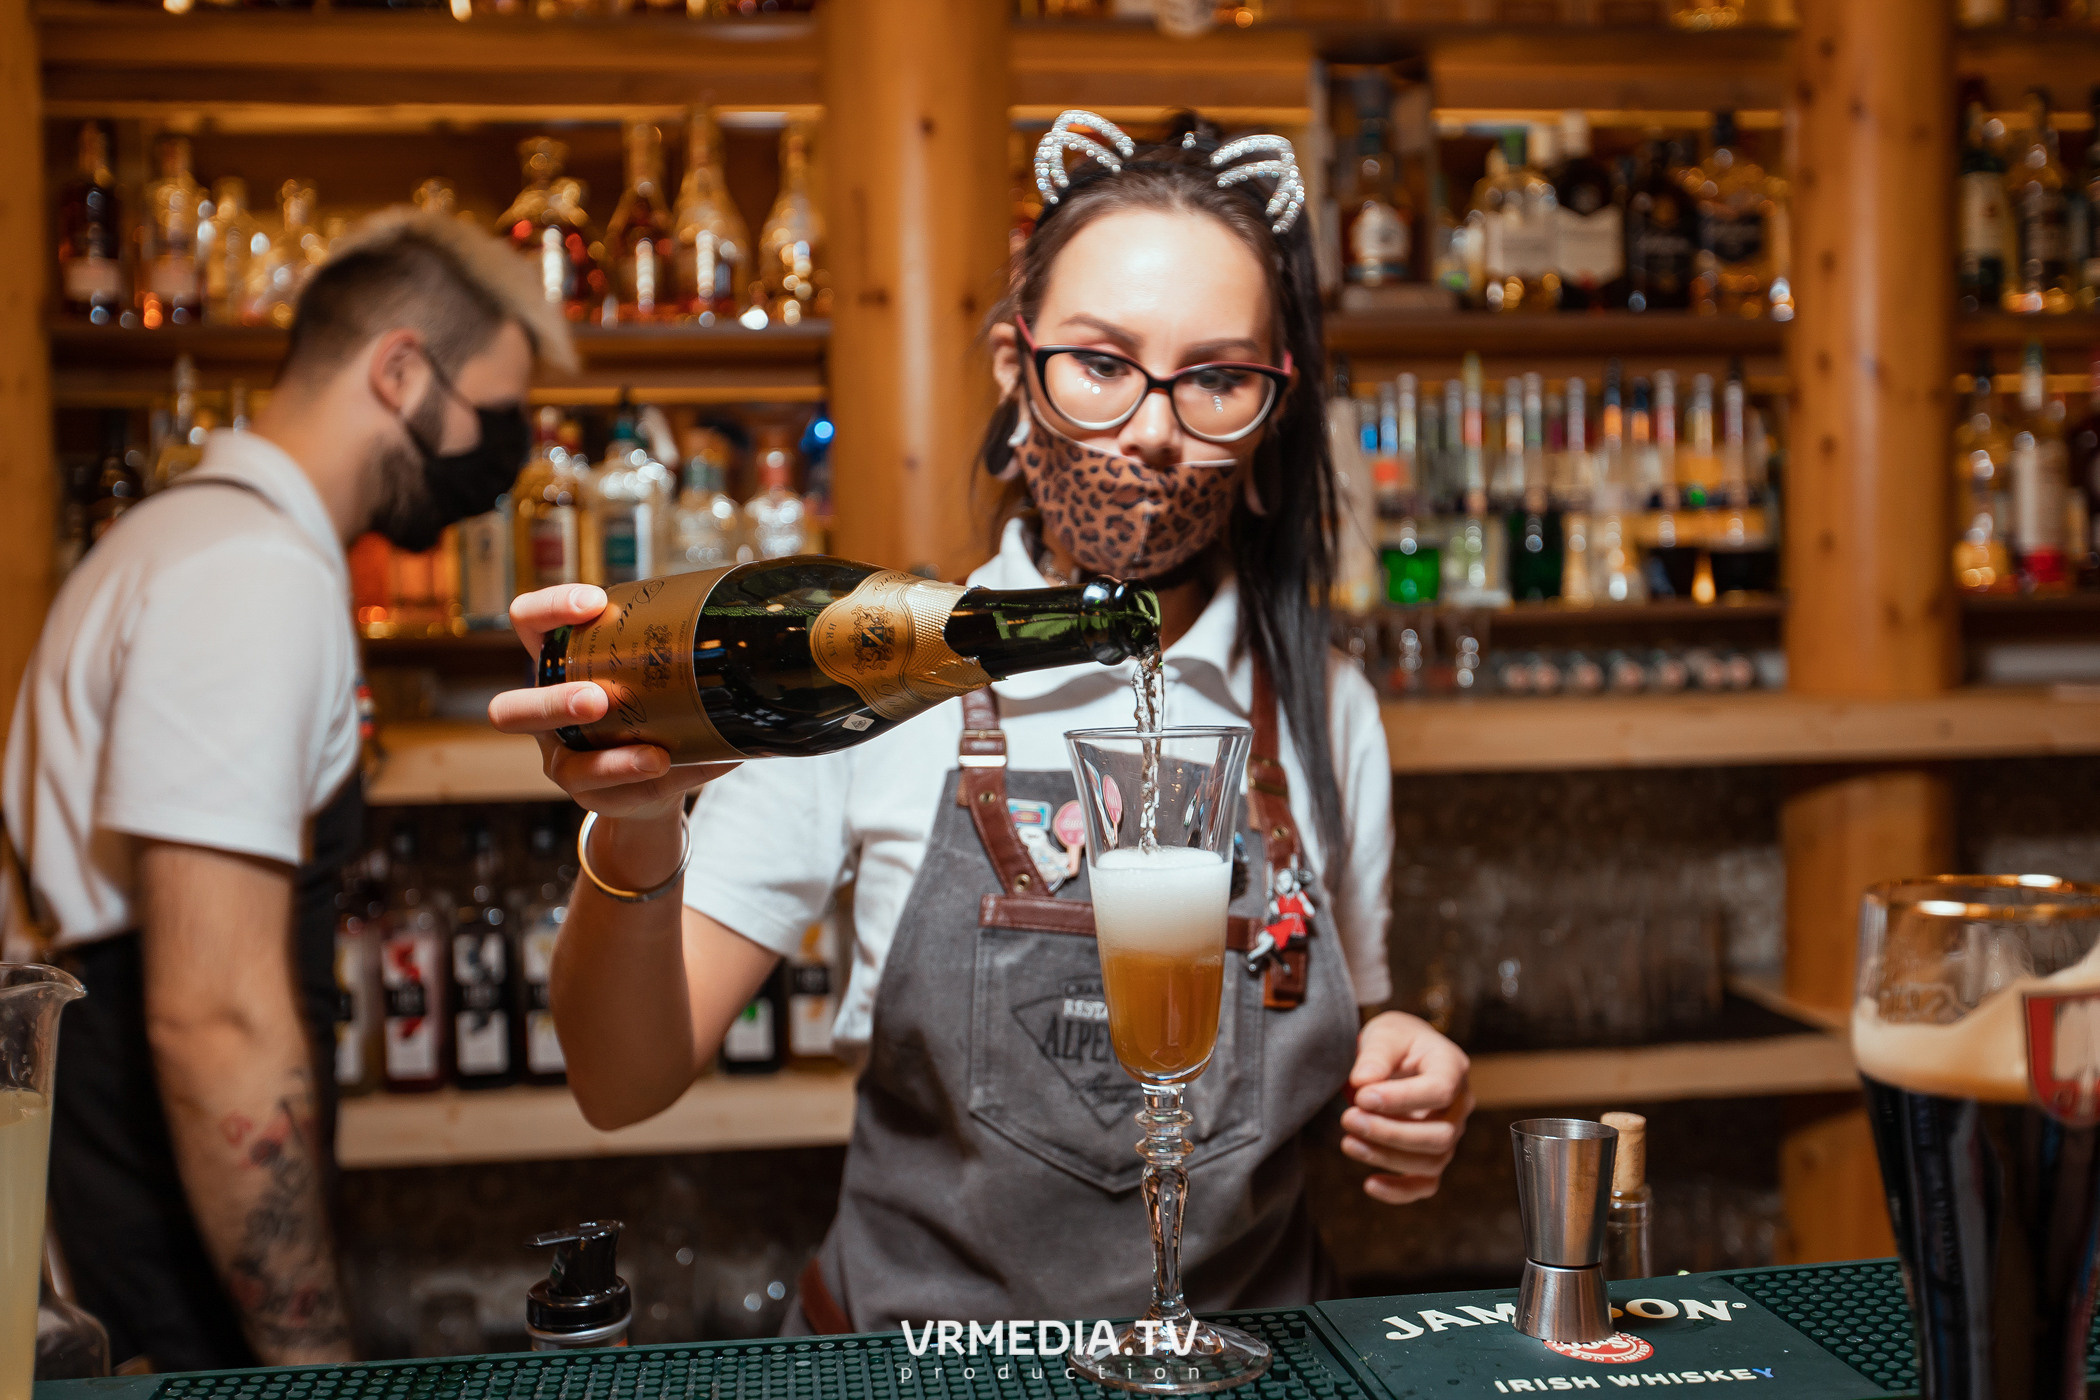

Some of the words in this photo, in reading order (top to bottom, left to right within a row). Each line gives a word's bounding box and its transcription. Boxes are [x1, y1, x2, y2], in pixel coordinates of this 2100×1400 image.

[617, 579, 665, 636] Duc
[608, 637, 623, 674] de
[631, 641, 639, 672] BRUT
[826, 621, 839, 659] BRUT
[1382, 1298, 1733, 1340] JAMON
[1611, 1344, 1651, 1362] LIMITED
[1494, 1376, 1601, 1394] IRISH
[1607, 1368, 1774, 1388] WHISKEY
